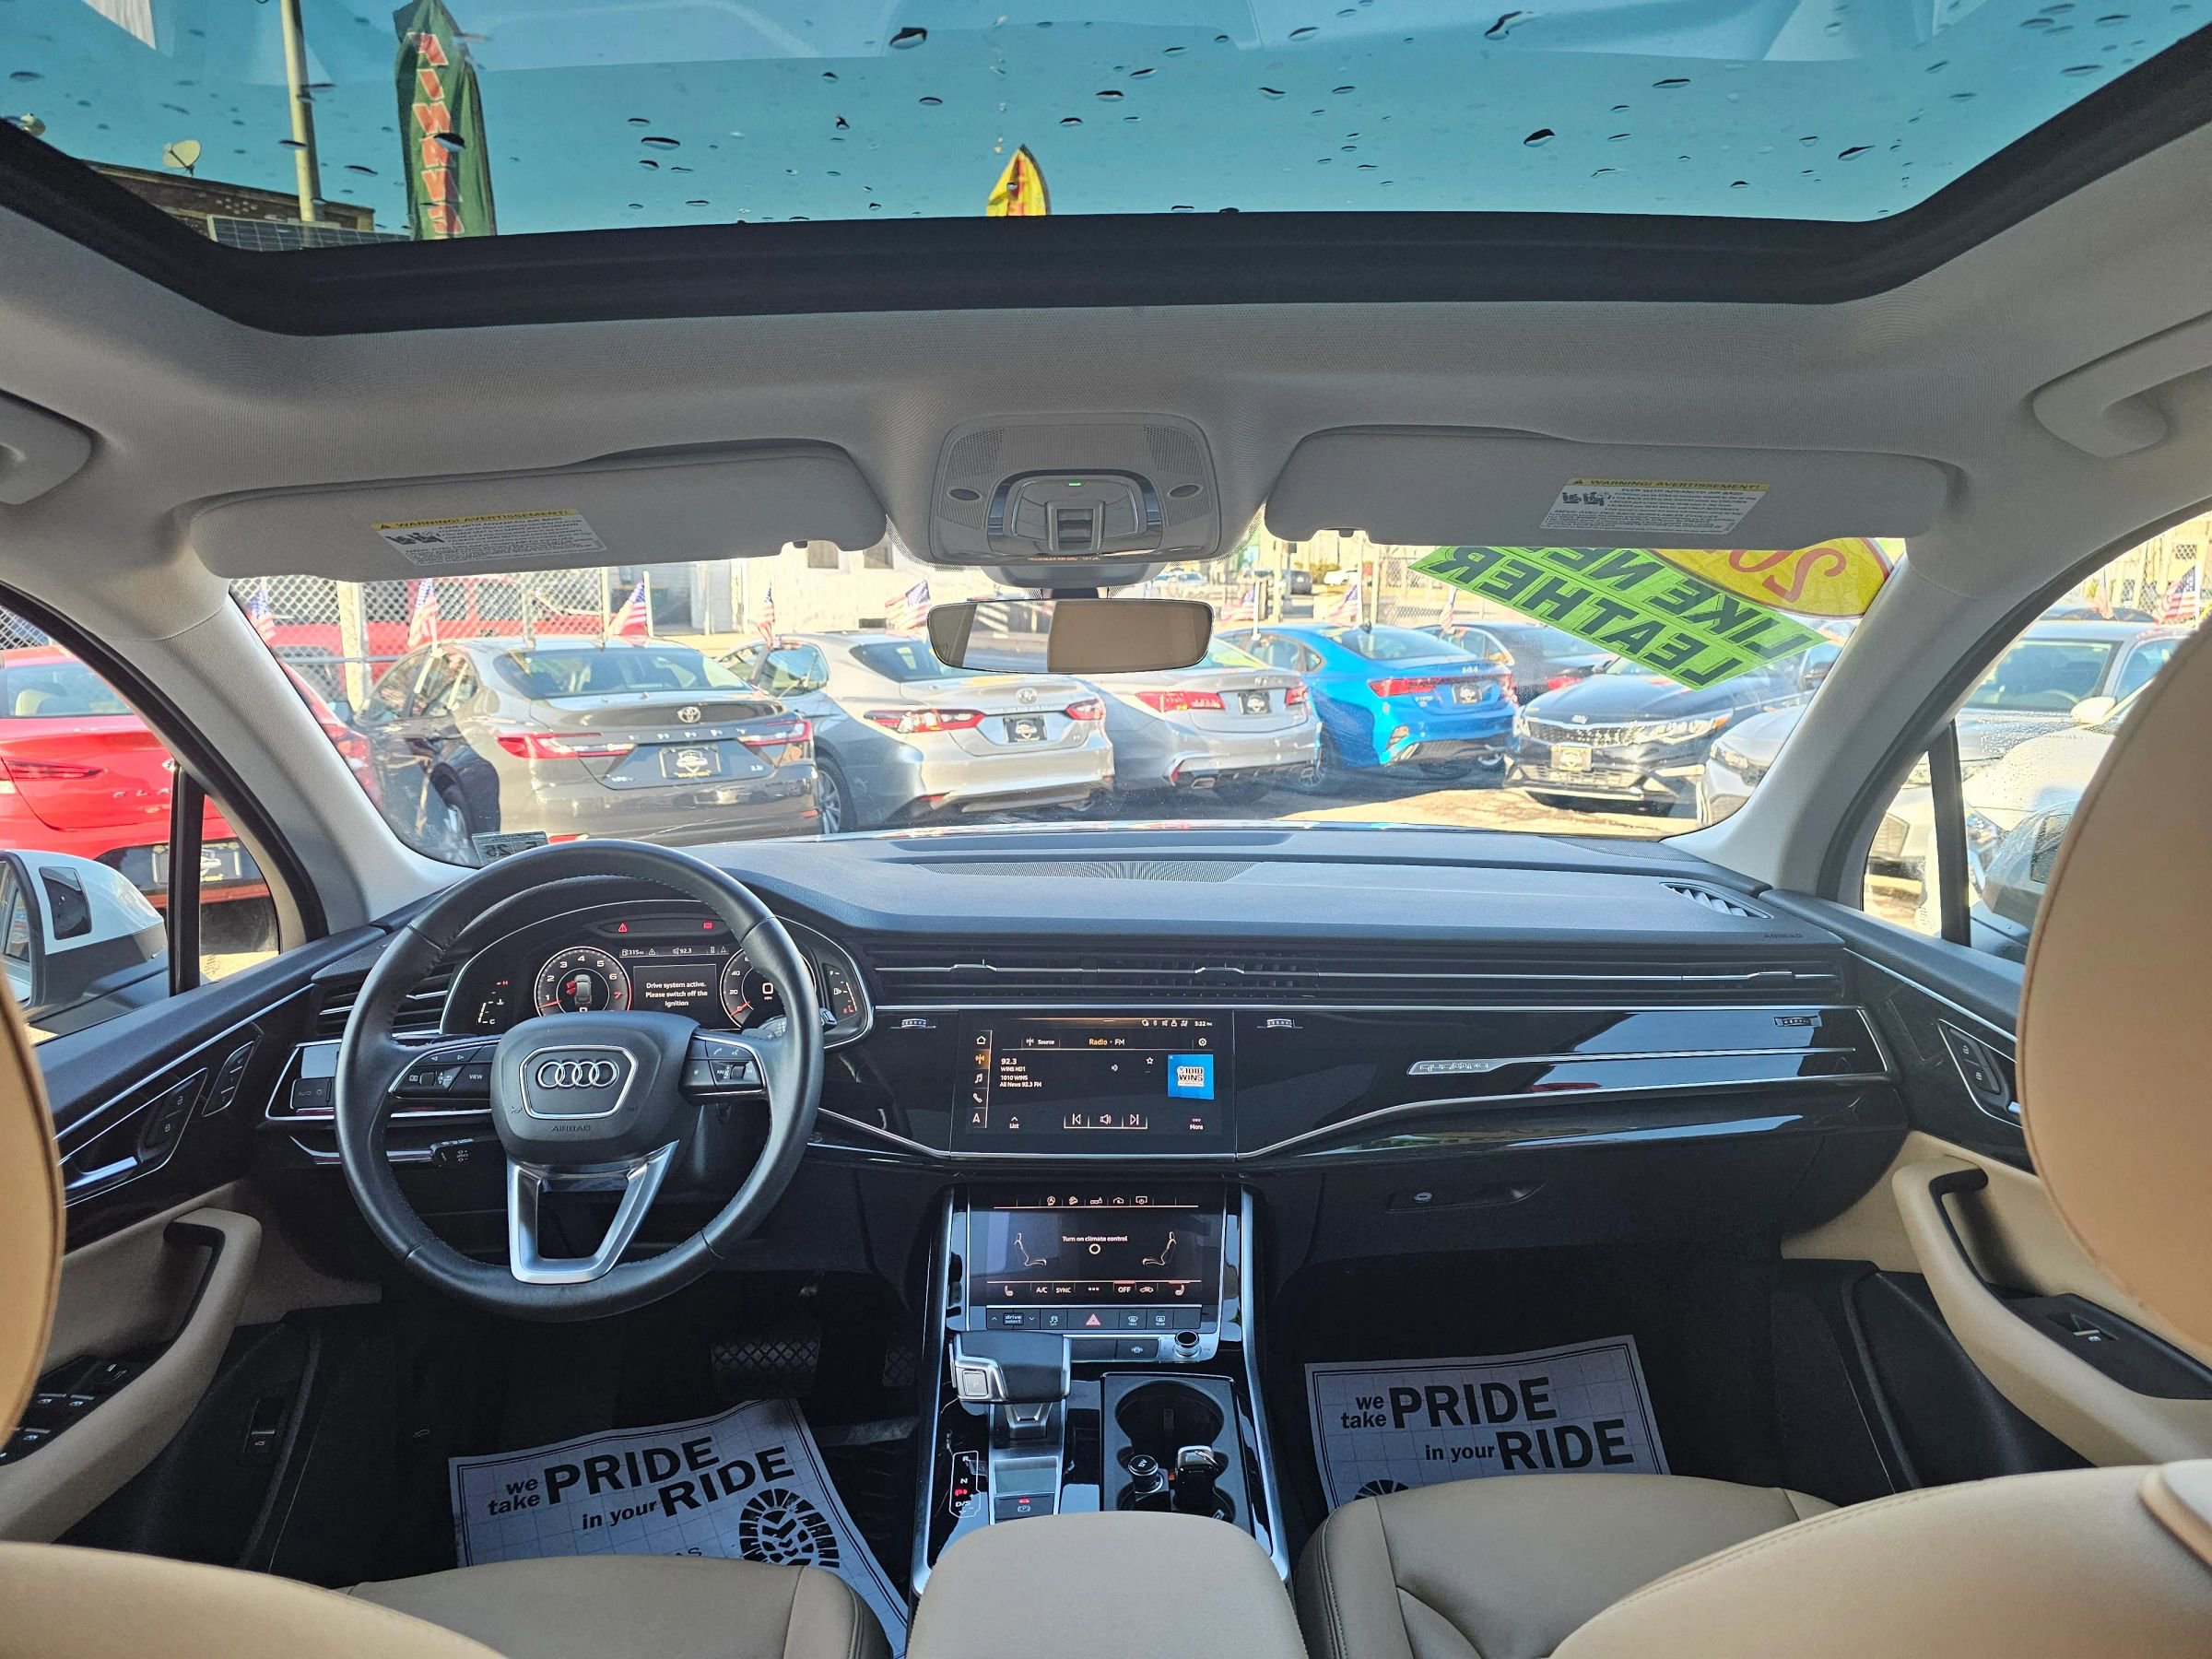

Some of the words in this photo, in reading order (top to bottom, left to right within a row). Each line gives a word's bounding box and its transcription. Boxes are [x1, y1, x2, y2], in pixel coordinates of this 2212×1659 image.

[664, 982, 686, 990] system
[1001, 1057, 1018, 1065] 92.3
[1340, 1411, 1387, 1430] take
[1388, 1376, 1558, 1430] PRIDE
[1355, 1396, 1384, 1411] we
[1425, 1444, 1444, 1461] in
[1451, 1443, 1495, 1464] your
[1495, 1418, 1634, 1471] RIDE
[487, 1491, 541, 1516] take
[543, 1436, 721, 1505] PRIDE
[505, 1477, 538, 1496] we
[582, 1512, 603, 1531] in
[609, 1500, 657, 1527] your
[658, 1445, 795, 1517] RIDE
[955, 1500, 971, 1508] D/S
